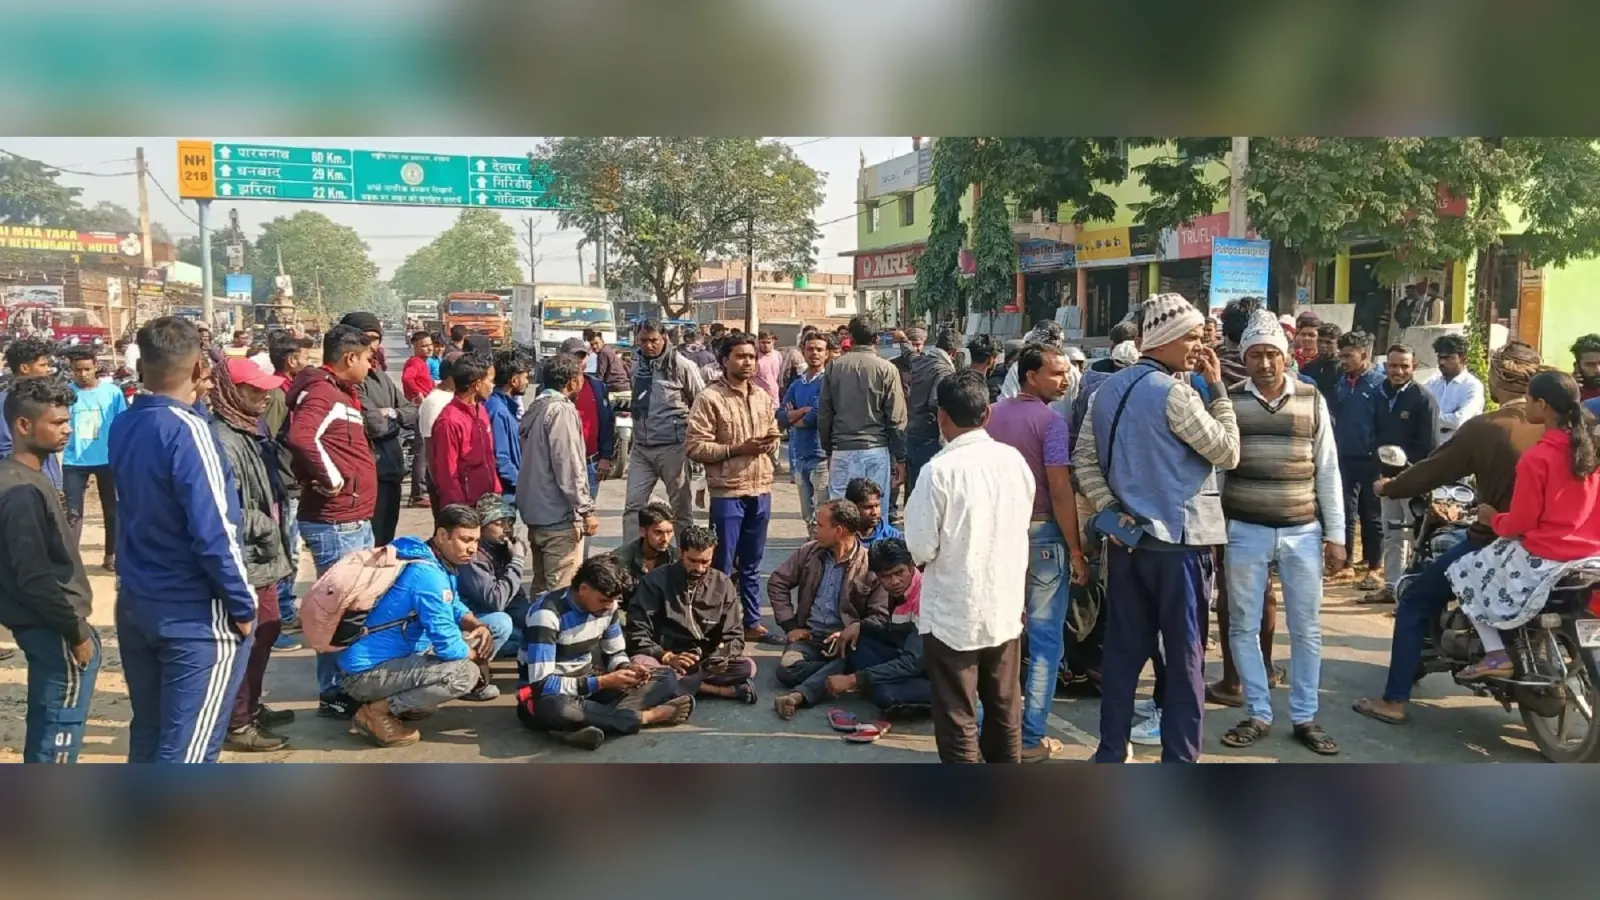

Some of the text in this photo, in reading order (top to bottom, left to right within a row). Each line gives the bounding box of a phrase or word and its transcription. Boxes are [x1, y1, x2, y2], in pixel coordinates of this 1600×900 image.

[184, 155, 206, 166] NH
[326, 151, 346, 164] Km.
[185, 171, 208, 182] 218
[237, 166, 347, 181] धनबाद 29 Km.
[237, 182, 348, 200] झरिया 22 Km.
[12, 226, 42, 237] MAA
[45, 228, 77, 239] TARA
[88, 243, 119, 253] HOTEL
[874, 254, 909, 276] MRF
